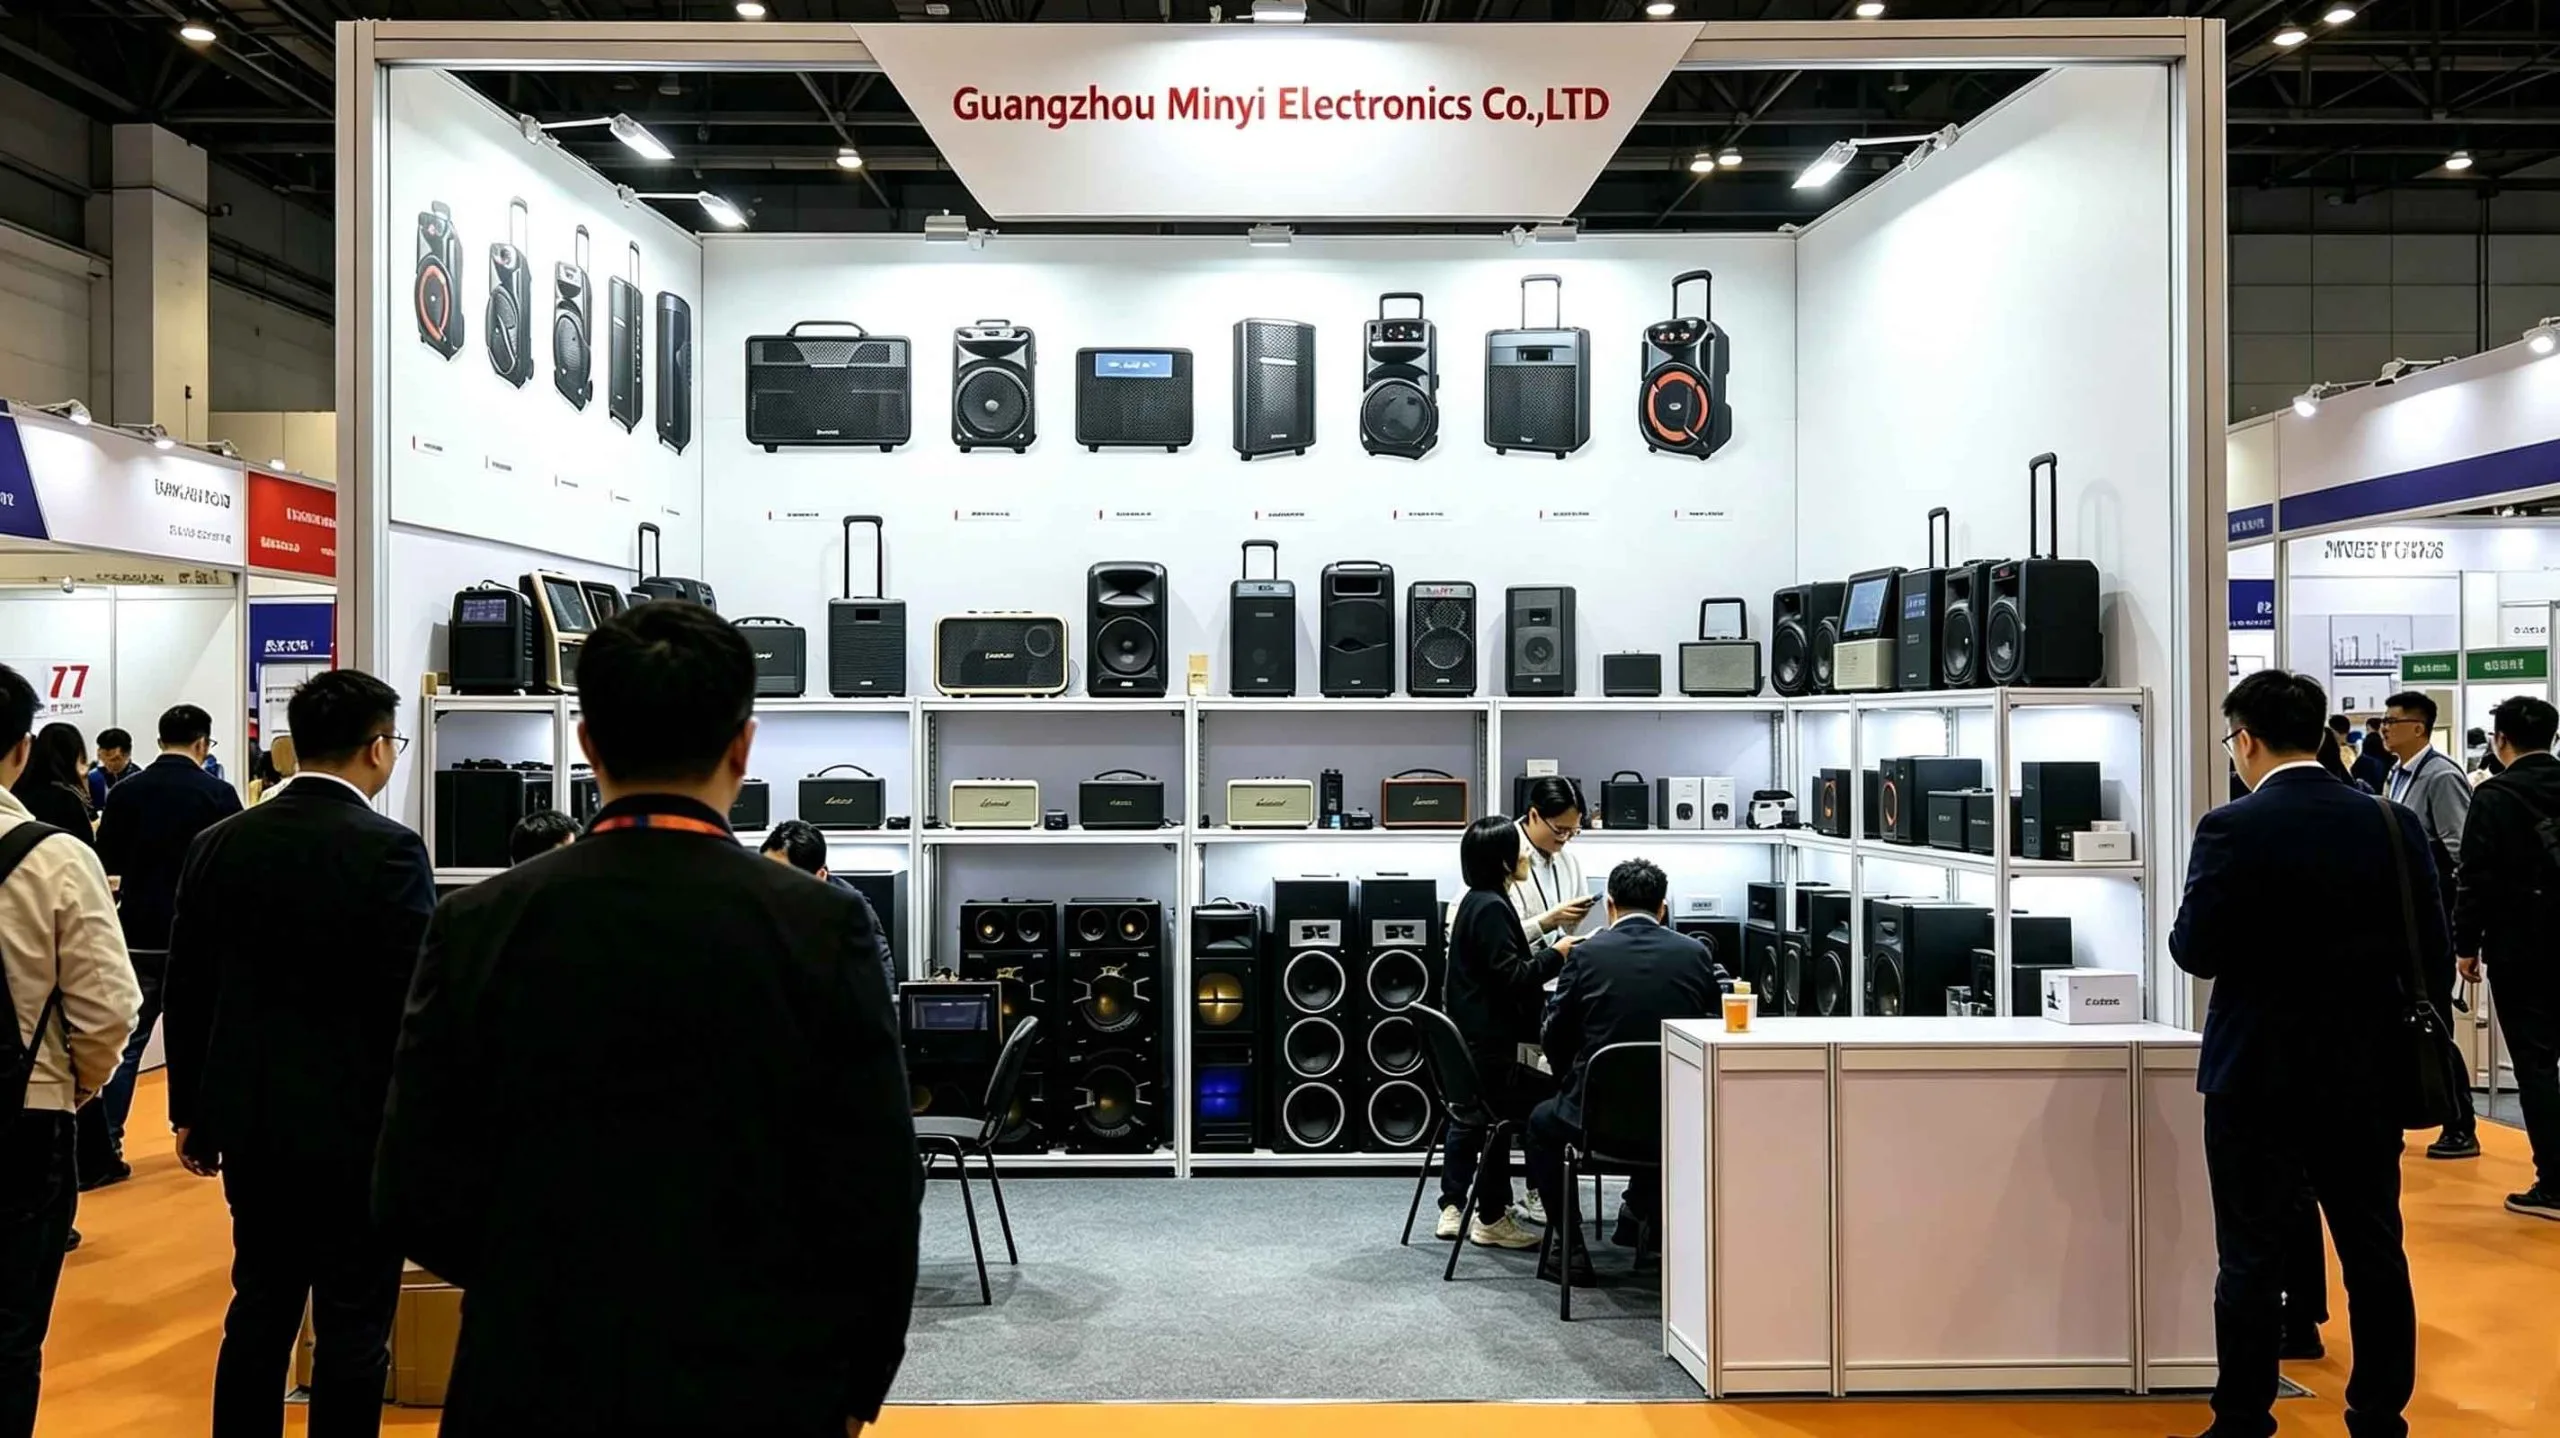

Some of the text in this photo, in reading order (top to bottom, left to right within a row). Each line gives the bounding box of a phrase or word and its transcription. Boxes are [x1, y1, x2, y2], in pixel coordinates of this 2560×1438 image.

[953, 85, 1610, 129] Guangzhou Minyi Electronics Co.,LTD
[49, 665, 89, 699] 77
